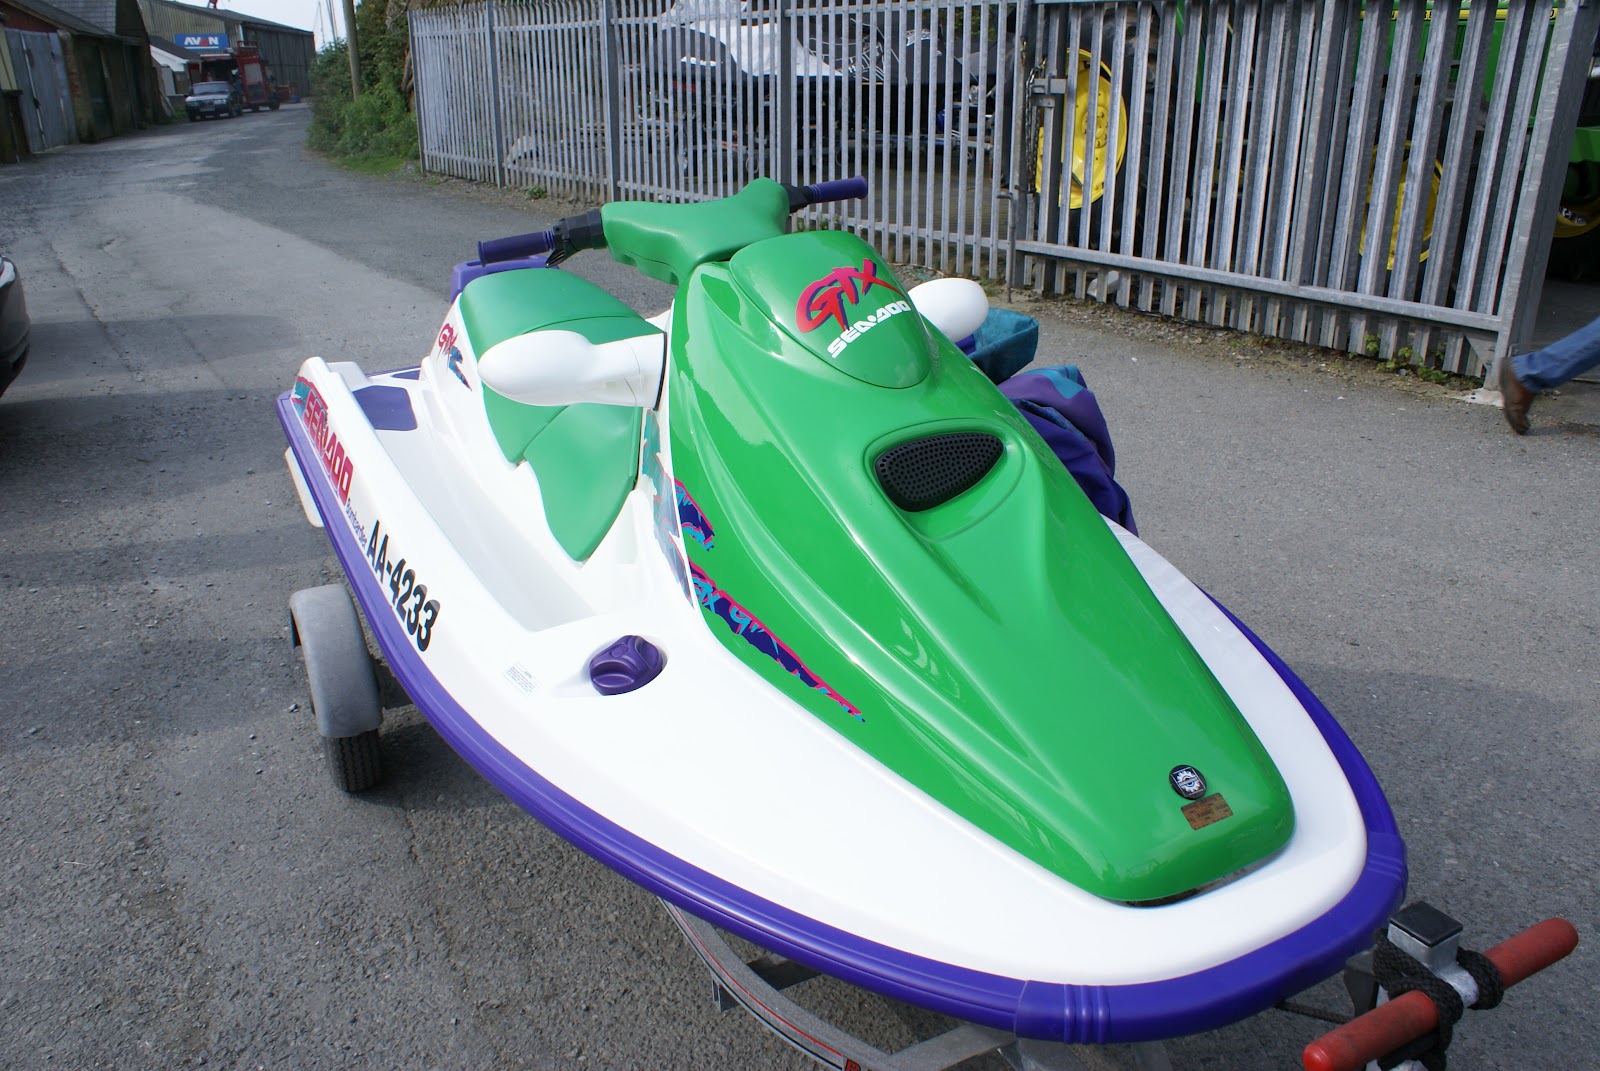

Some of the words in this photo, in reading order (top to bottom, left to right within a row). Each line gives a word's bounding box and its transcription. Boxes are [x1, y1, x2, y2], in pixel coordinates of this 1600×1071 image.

[184, 36, 219, 48] AVON
[795, 258, 908, 333] GTX
[366, 519, 441, 652] AA-4233
